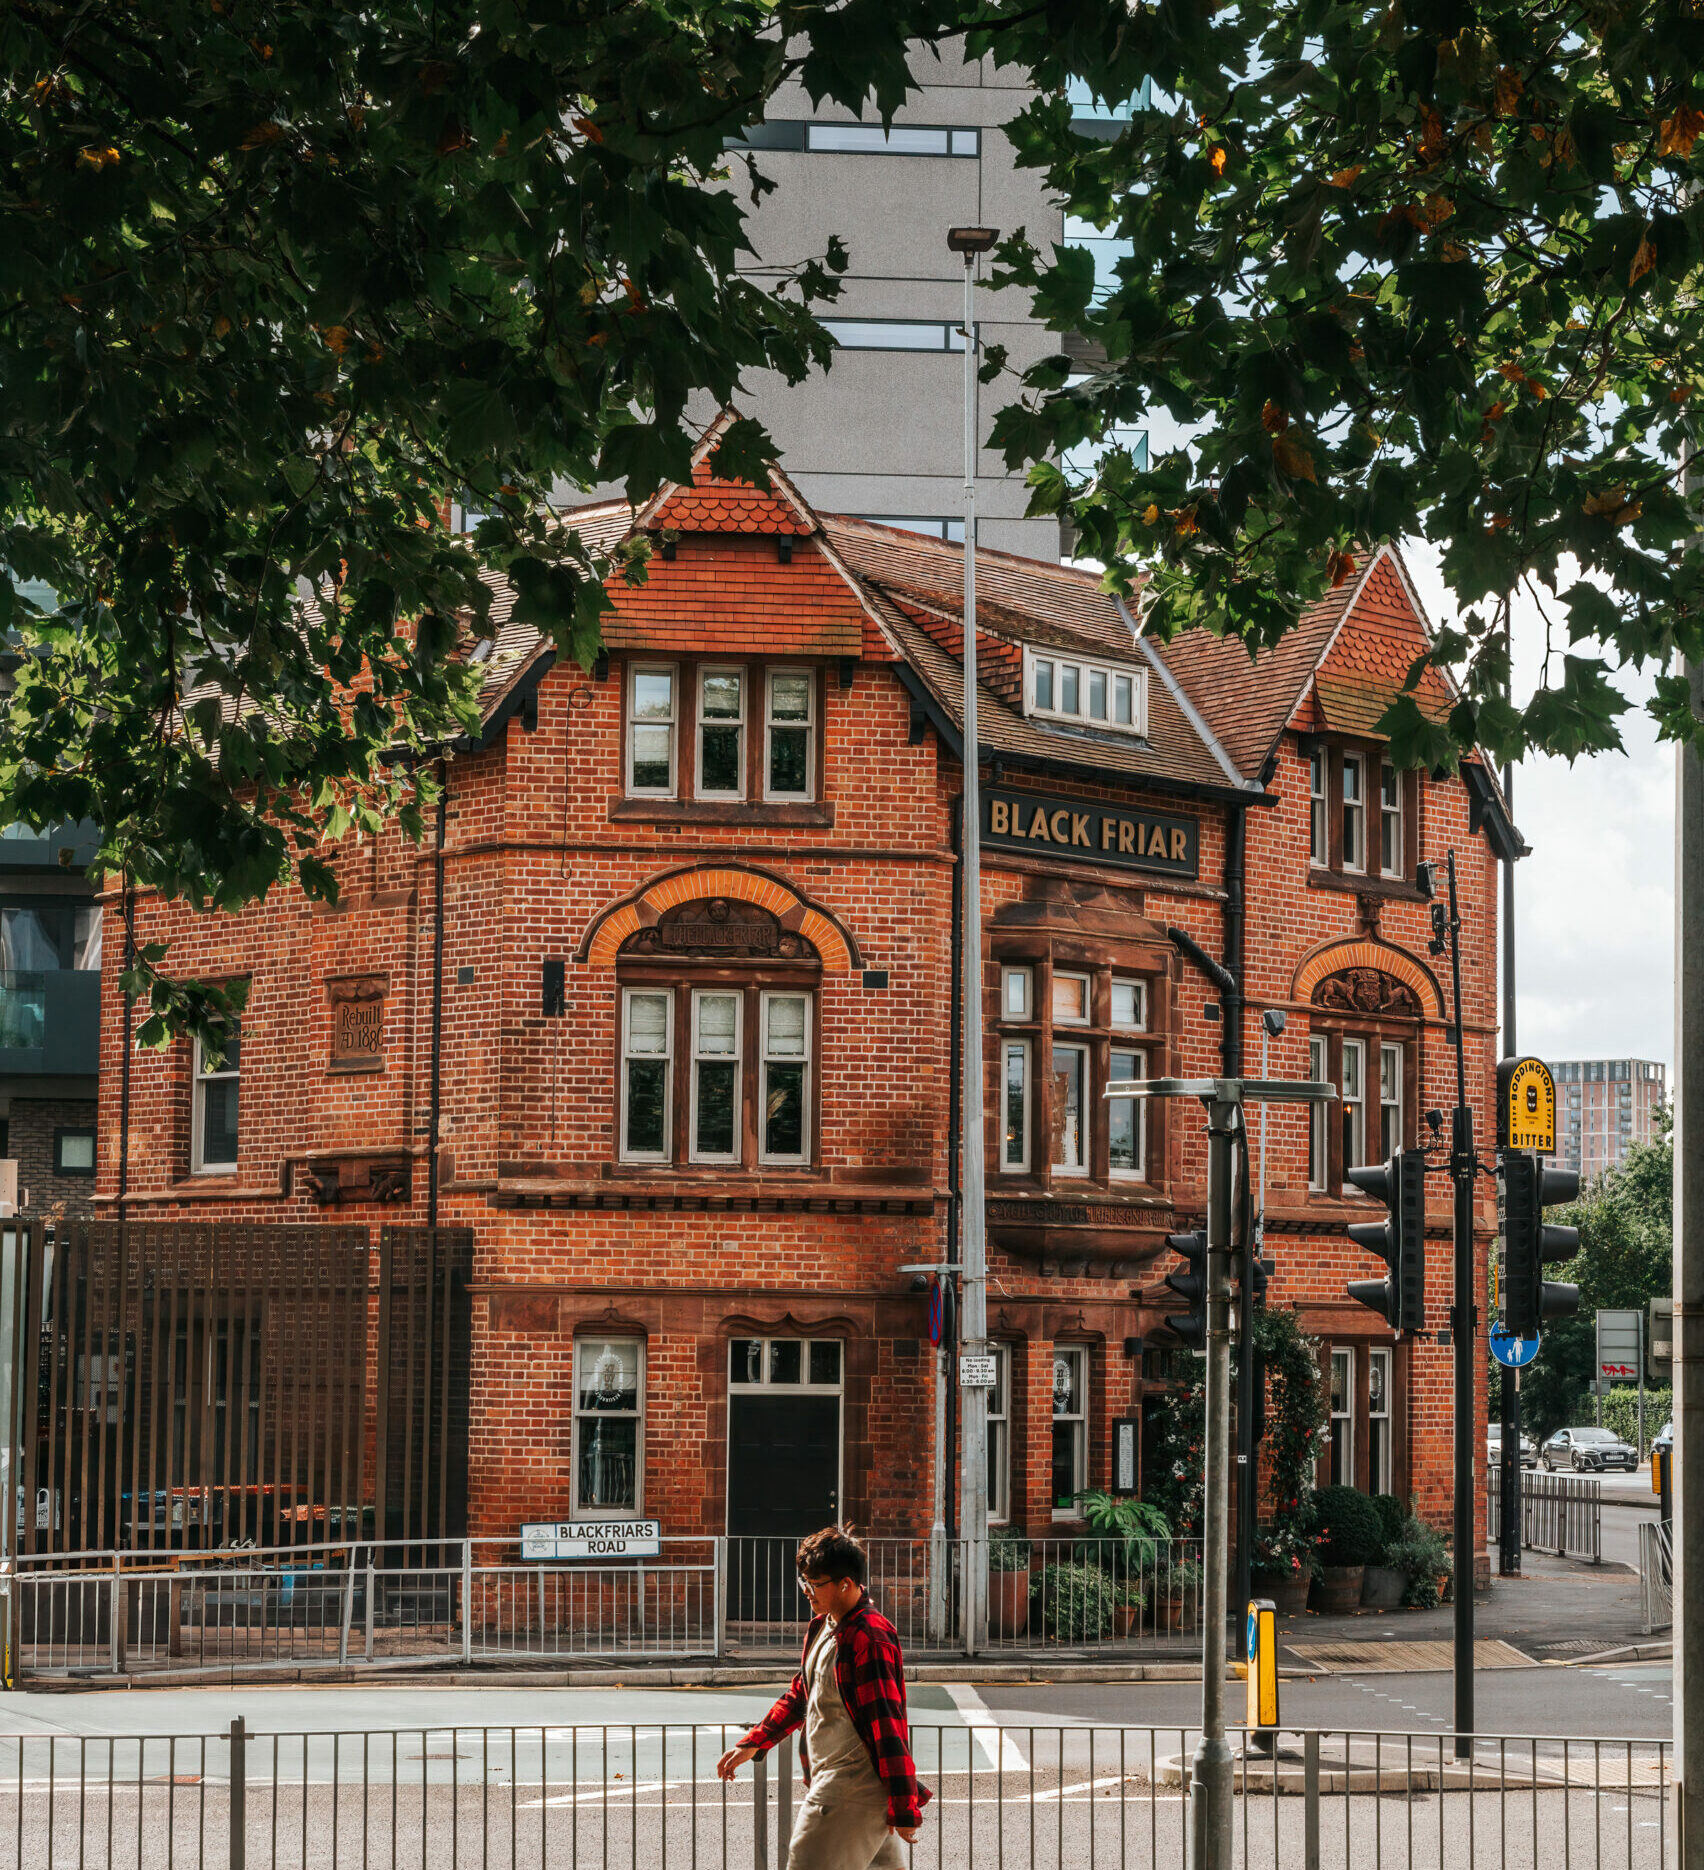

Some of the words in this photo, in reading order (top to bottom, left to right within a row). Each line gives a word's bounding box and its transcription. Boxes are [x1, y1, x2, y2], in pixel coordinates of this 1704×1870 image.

[991, 799, 1092, 847] BLACK
[1102, 817, 1187, 862] FRIAR
[342, 1005, 383, 1030] Rebuilt
[358, 1025, 384, 1053] 1886
[1511, 1062, 1552, 1104] BODDINGTONS
[1512, 1133, 1552, 1147] BITTER
[559, 1524, 654, 1539] BLACKFRIARS
[587, 1540, 627, 1554] ROAD
